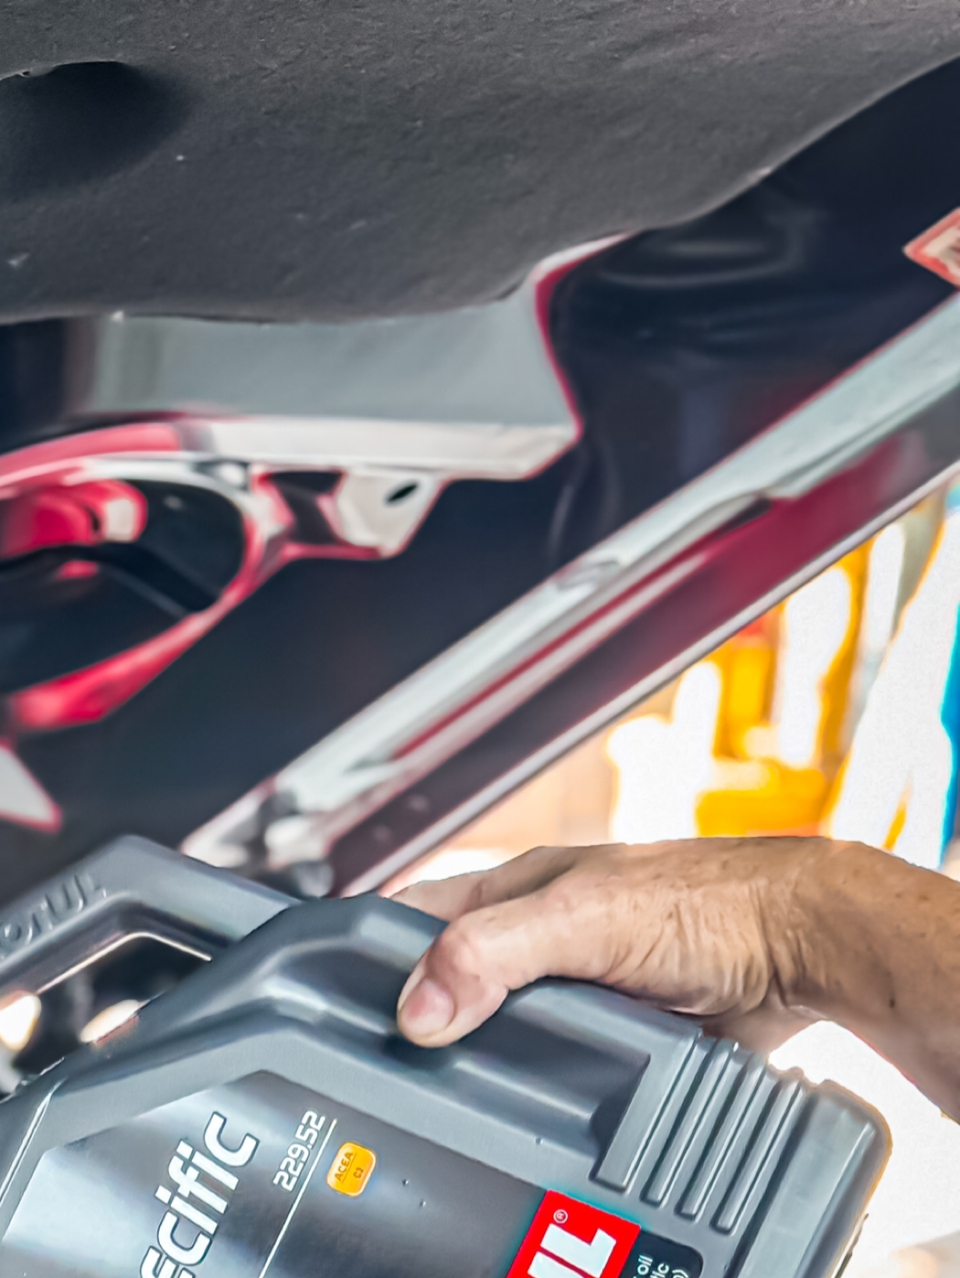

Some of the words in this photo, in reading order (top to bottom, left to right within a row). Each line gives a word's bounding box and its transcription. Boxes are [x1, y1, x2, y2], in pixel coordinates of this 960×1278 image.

[272, 1110, 326, 1192] 229.52
[334, 1151, 354, 1182] ACEA
[637, 1255, 653, 1276] oil
